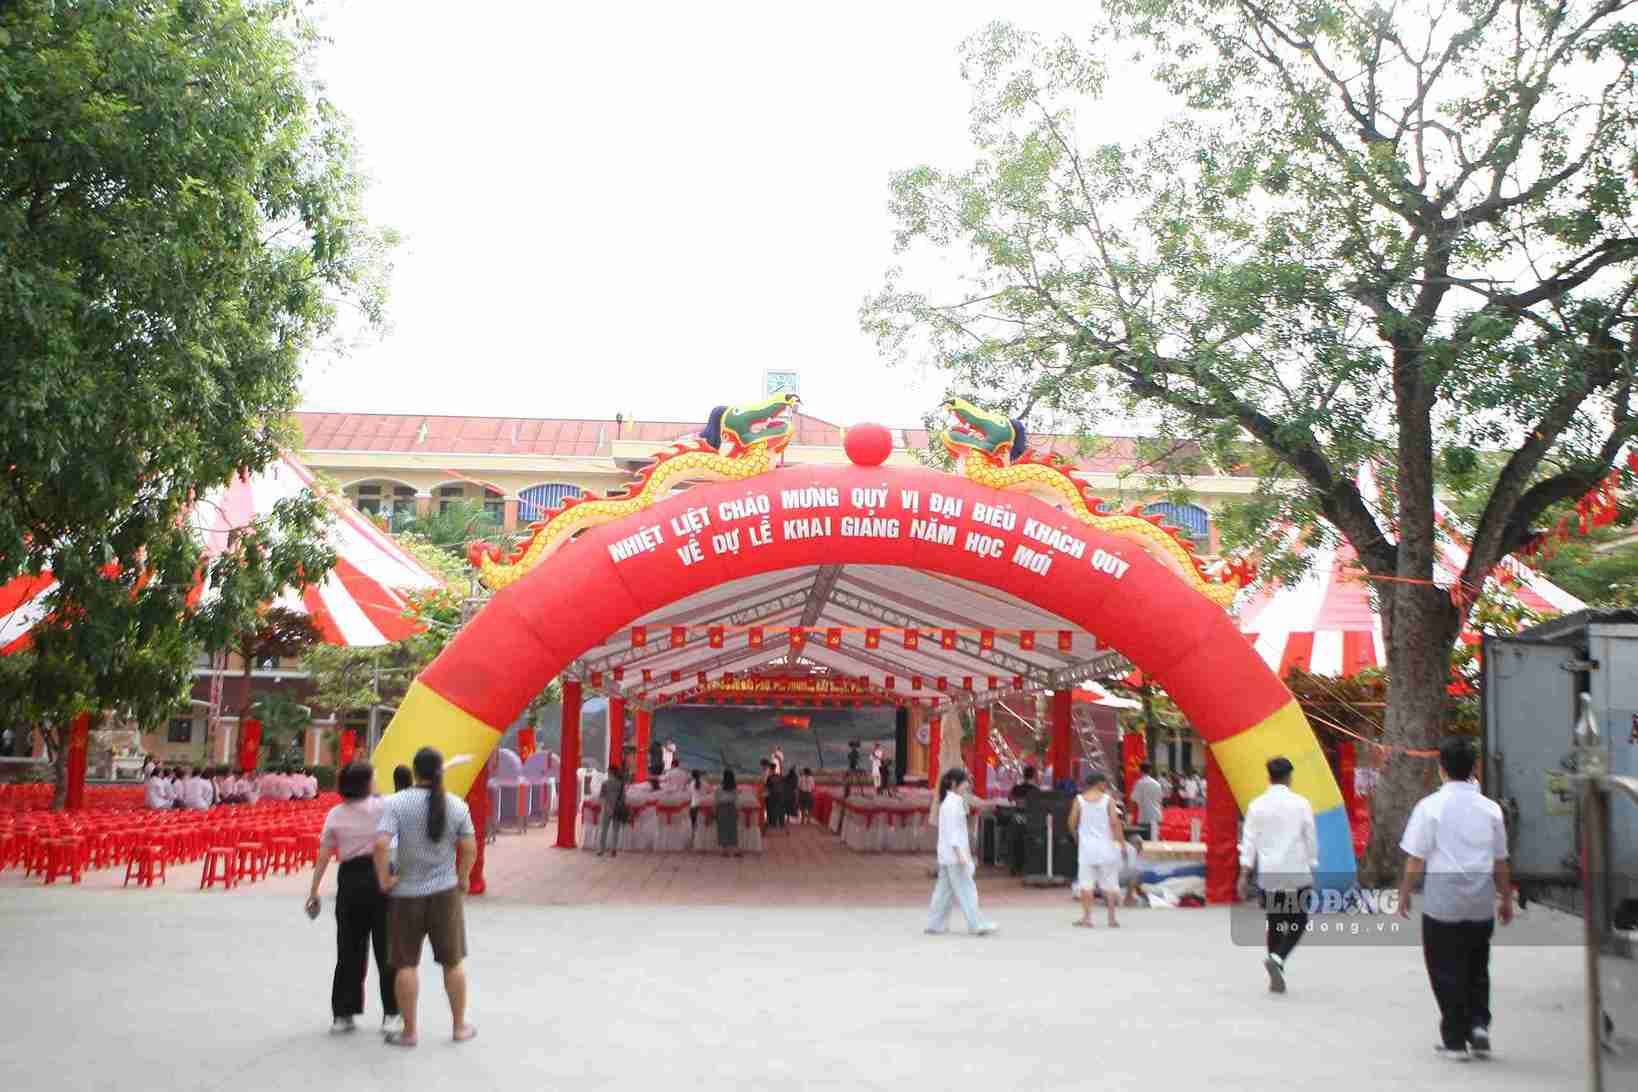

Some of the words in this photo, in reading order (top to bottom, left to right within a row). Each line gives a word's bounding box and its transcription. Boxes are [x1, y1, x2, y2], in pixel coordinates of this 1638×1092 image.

[608, 525, 664, 563] NHIỆT
[670, 507, 712, 537] LIỆT
[851, 482, 888, 508] QUÝ
[901, 489, 919, 513] VỊ
[929, 493, 963, 519] ĐẠI
[1023, 517, 1086, 559] KHÁCH
[1091, 548, 1130, 579] QUÝ
[677, 533, 704, 566] VỀ
[712, 528, 740, 555] DỰ
[749, 514, 773, 546] LỄ
[783, 516, 832, 540] KHAI
[841, 508, 899, 538] GIẢNG
[910, 517, 957, 545] NĂM
[964, 532, 1005, 559] HỌC
[1011, 543, 1053, 577] MỚI
